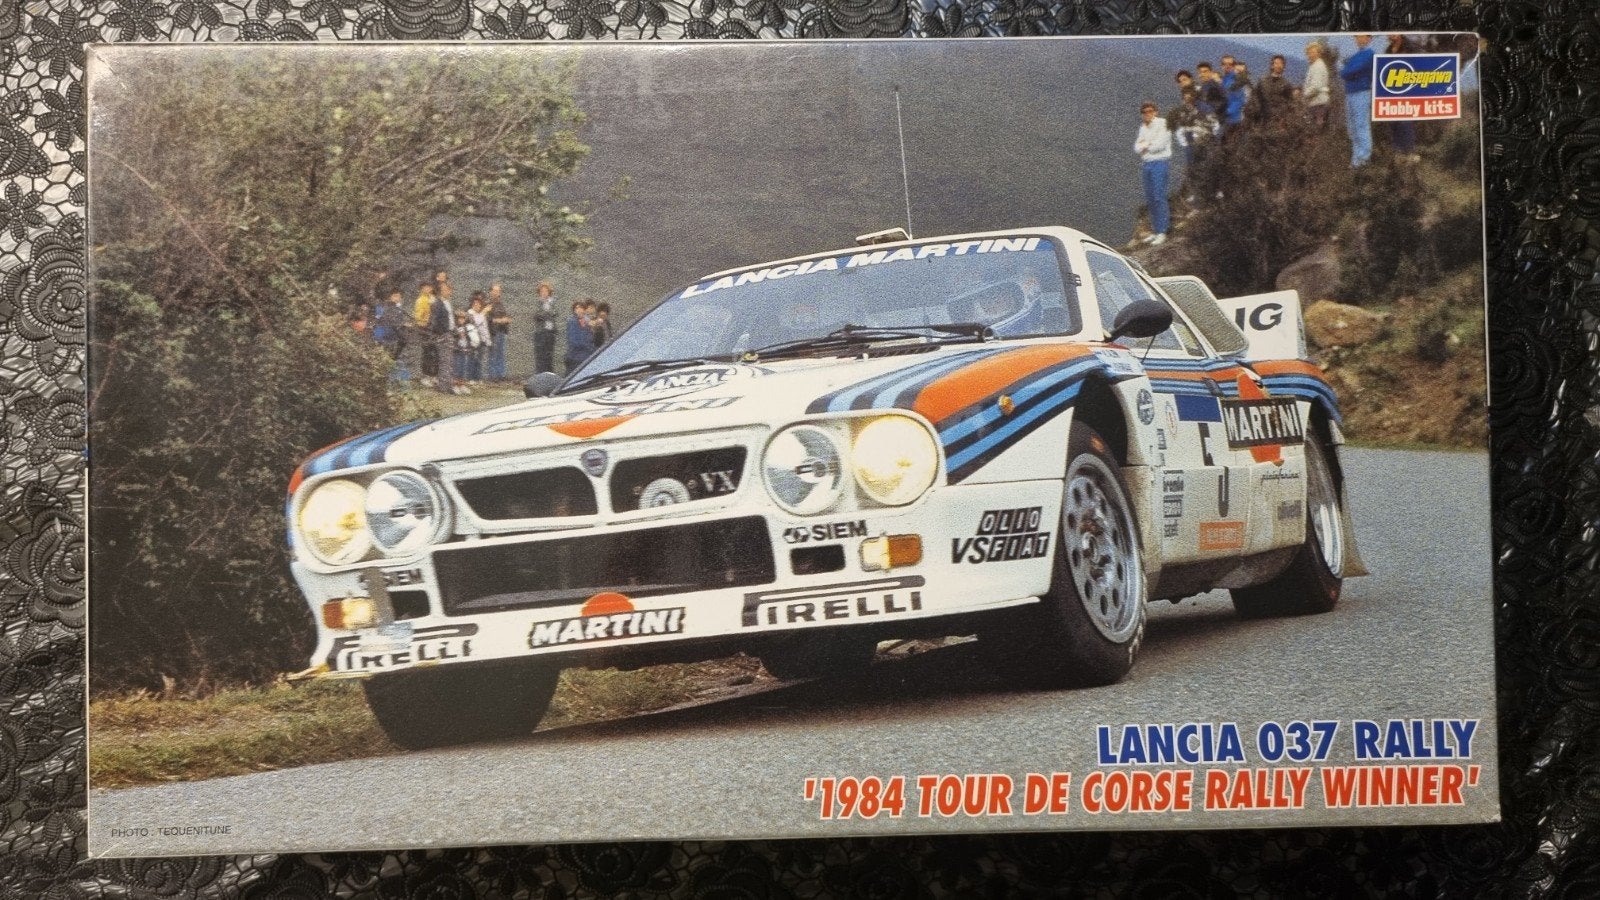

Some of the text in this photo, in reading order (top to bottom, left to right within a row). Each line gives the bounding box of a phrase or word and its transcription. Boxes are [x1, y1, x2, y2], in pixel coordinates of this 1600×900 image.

[1385, 68, 1453, 88] Hasegawa
[1378, 100, 1453, 117] Hobby kits
[680, 238, 1041, 299] LANCIA MARTINI
[1223, 401, 1301, 442] MARTINI
[700, 469, 736, 493] VX
[808, 520, 868, 541] SIEM
[979, 508, 1041, 534] OLIO
[741, 575, 926, 627] PIRELLI
[530, 607, 684, 648] MARTINI
[1097, 719, 1480, 766] LANCIA 037 RALLY
[917, 773, 1013, 818] TOUR
[1023, 772, 1072, 815] DE
[1081, 769, 1194, 815] CORSE
[1204, 766, 1313, 811] RALLY
[111, 828, 149, 838] PHOTO
[157, 825, 231, 836] TEQUENITUNE
